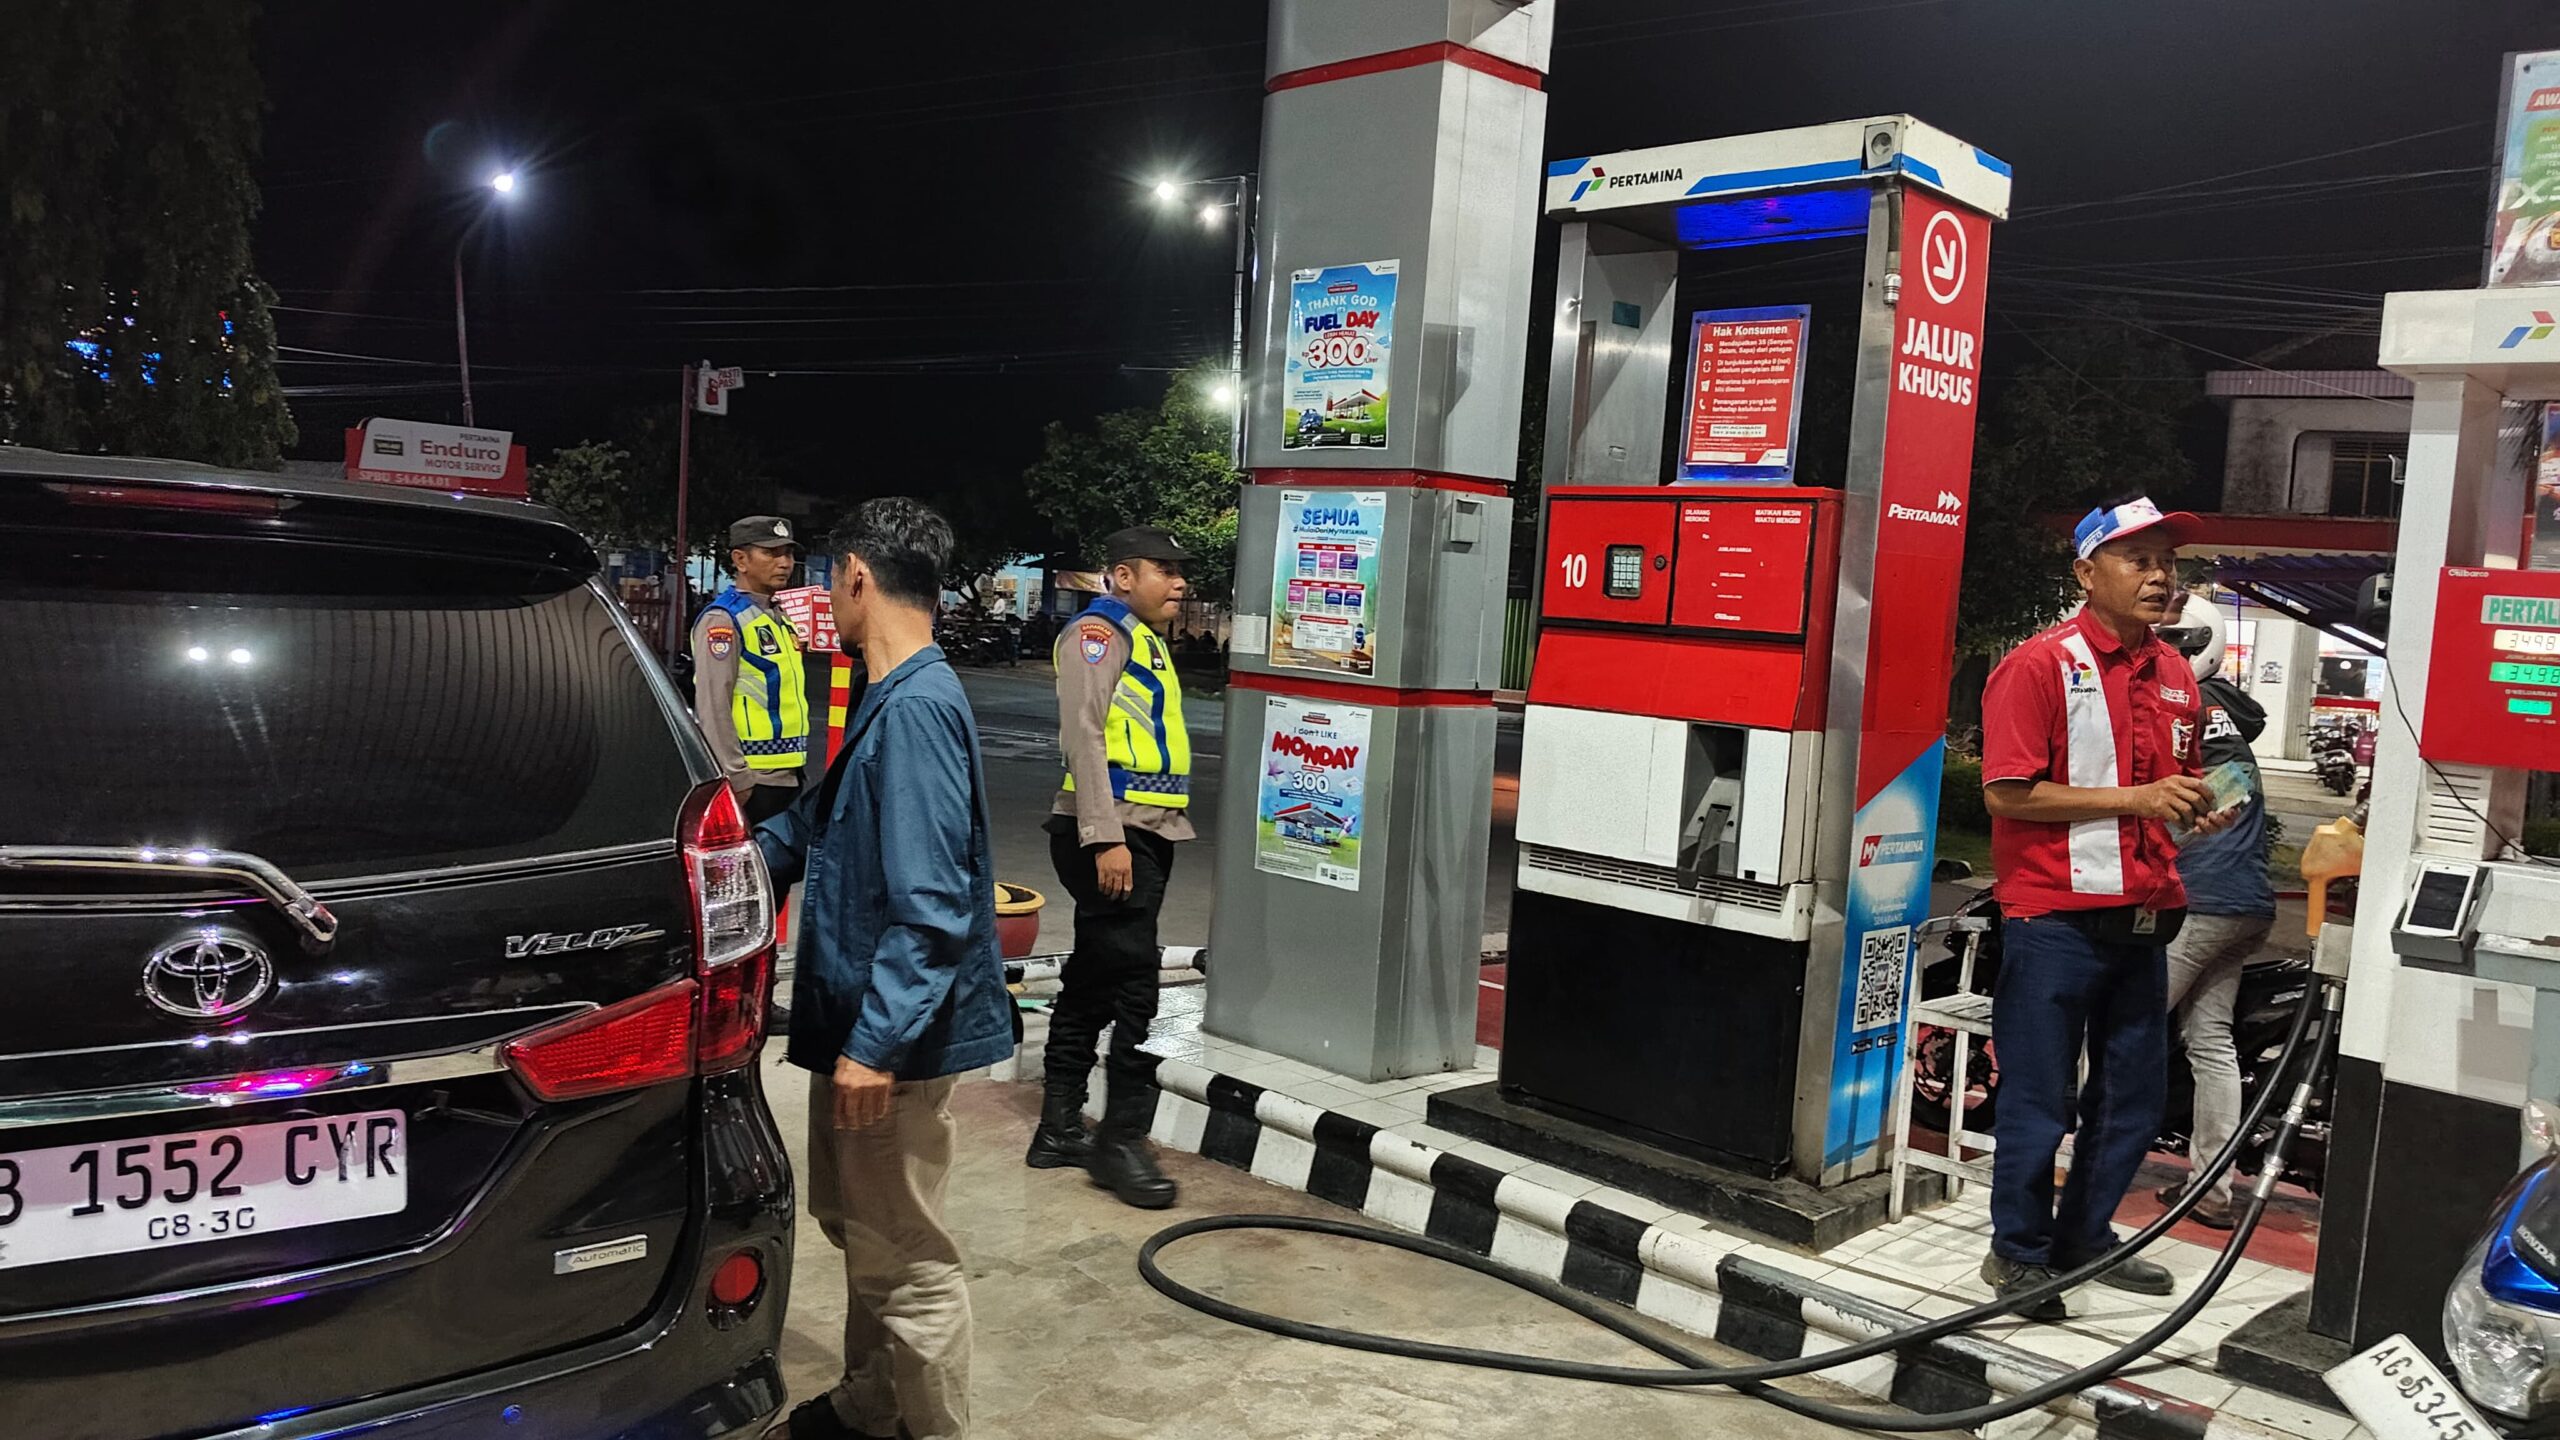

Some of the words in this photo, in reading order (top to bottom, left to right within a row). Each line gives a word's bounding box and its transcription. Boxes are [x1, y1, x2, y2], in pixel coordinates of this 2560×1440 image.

[1610, 167, 1684, 189] PERTAMINA
[1307, 295, 1347, 311] THANK
[1350, 294, 1377, 307] GOD
[1304, 313, 1342, 333] FUEL
[1346, 310, 1380, 329] DAY
[1712, 326, 1732, 337] Hak
[1734, 325, 1788, 336] Konsumen
[1308, 336, 1370, 369] 300
[1902, 317, 1974, 370] JALUR
[1898, 362, 1972, 406] KHUSUS
[420, 440, 500, 461] Enduro
[358, 470, 390, 482] SPBU
[425, 458, 461, 470] MOTOR
[465, 461, 501, 473] SERVICE
[1301, 508, 1360, 527] SEMUA
[1887, 502, 1961, 527] PERTAMAX
[1561, 553, 1588, 588] 10
[2489, 597, 2560, 624] PERTAL
[1320, 730, 1338, 739] LIKE
[1271, 730, 1360, 771] MONDAY
[1292, 770, 1330, 794] 300
[69, 1135, 243, 1217] 1552
[285, 1116, 399, 1187] CYR
[571, 1242, 646, 1265] Automatic
[2516, 1224, 2557, 1267] HONDA
[2369, 1346, 2413, 1377] AG
